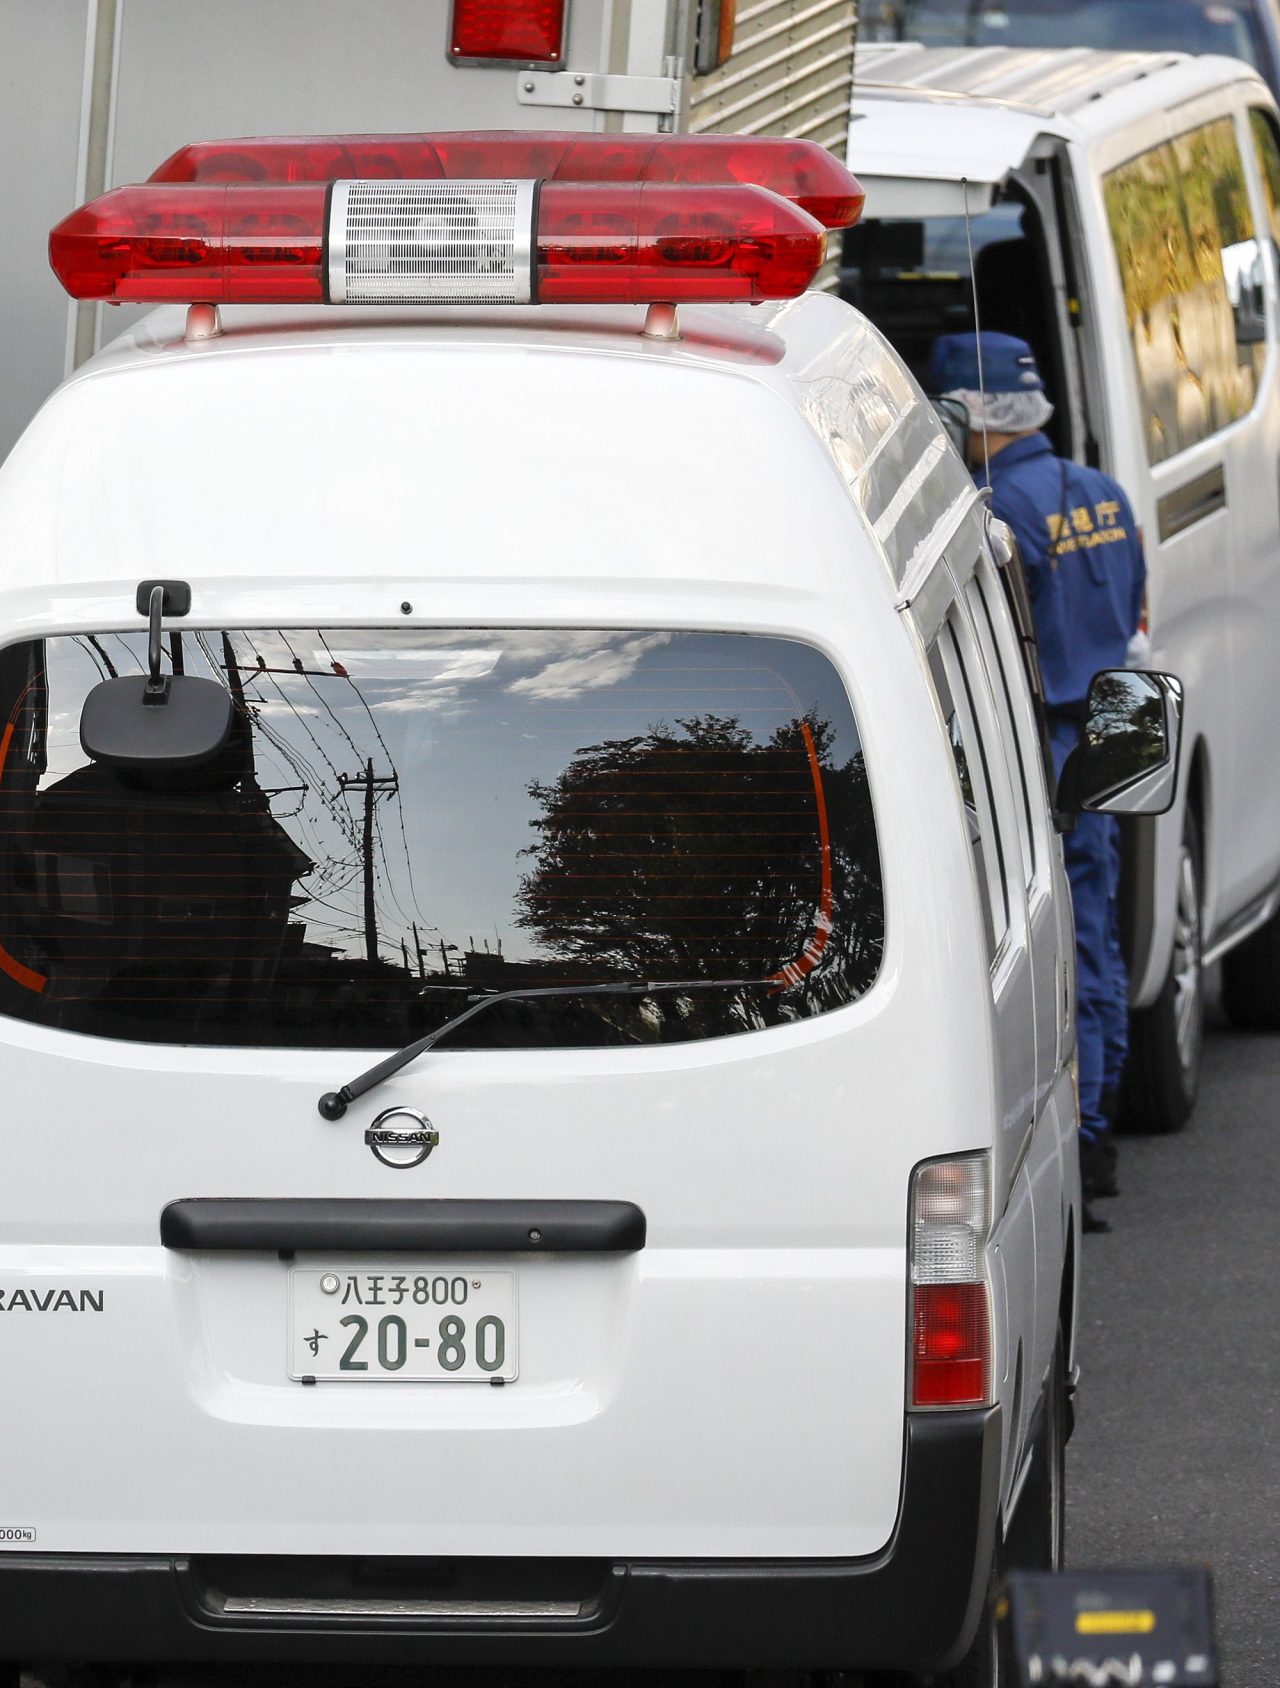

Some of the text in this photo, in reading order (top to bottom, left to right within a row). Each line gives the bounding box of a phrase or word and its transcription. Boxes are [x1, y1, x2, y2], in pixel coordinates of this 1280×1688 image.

[371, 1132, 432, 1144] NISSAN
[341, 1276, 468, 1305] 八王子800
[303, 1314, 505, 1371] す 20-80
